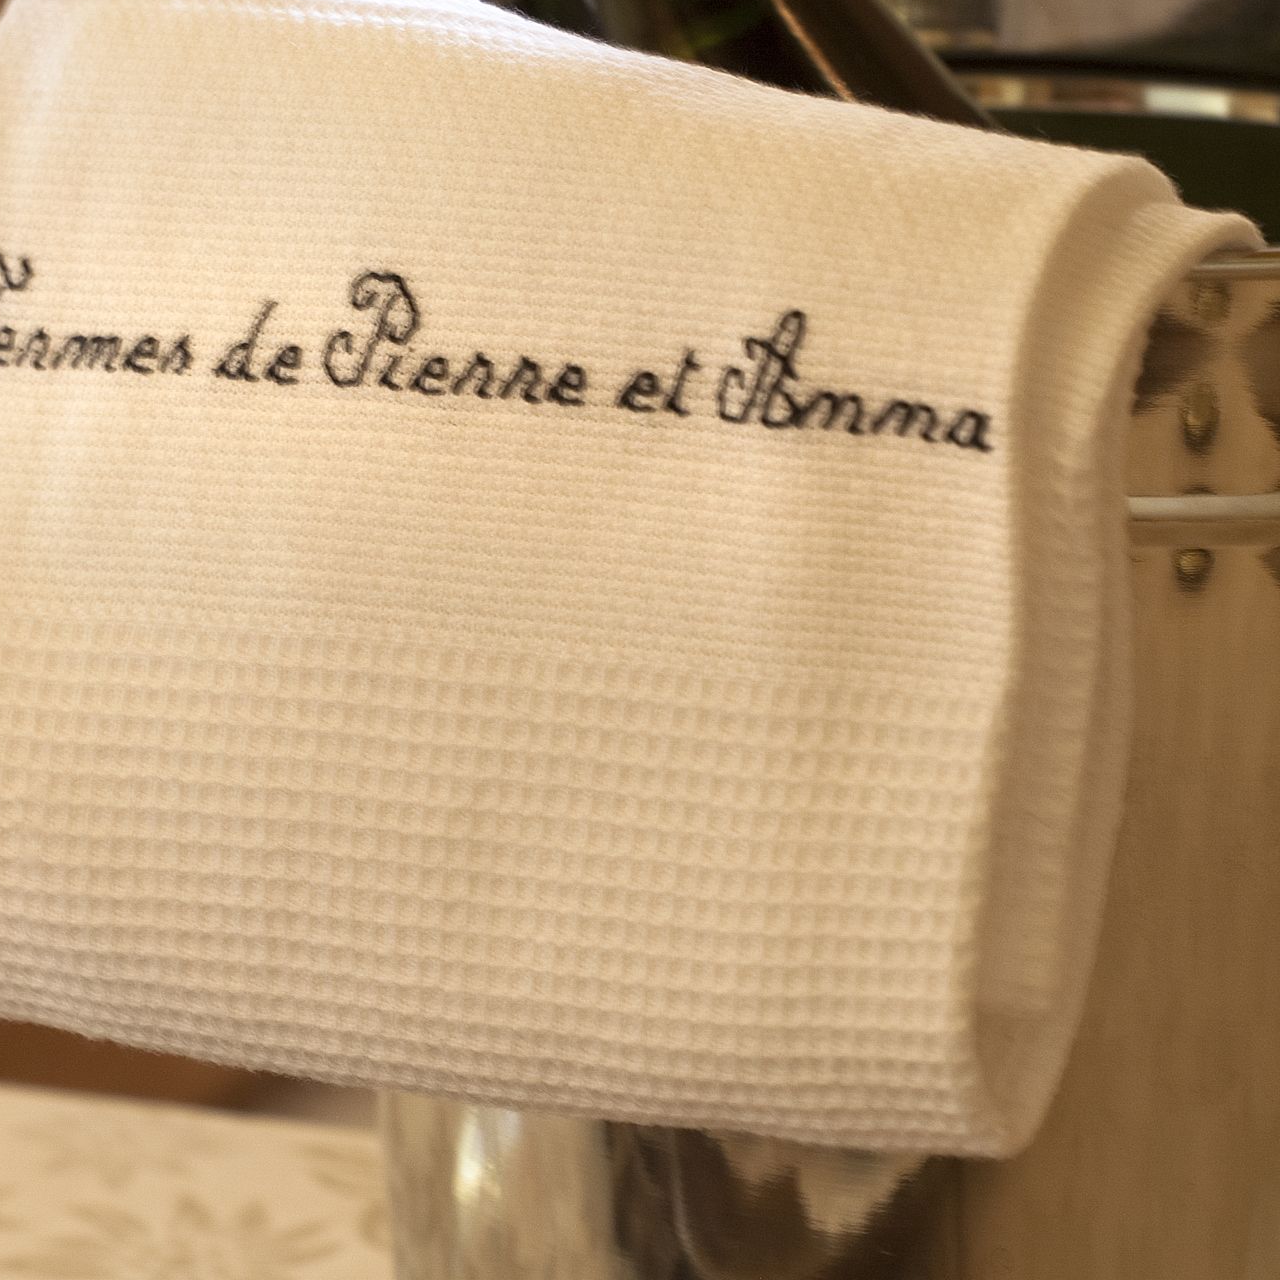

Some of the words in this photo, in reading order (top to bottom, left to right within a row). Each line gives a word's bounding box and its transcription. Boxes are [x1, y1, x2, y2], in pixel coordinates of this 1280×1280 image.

[213, 298, 304, 384] de
[322, 270, 587, 406] Pierre
[619, 348, 700, 417] et
